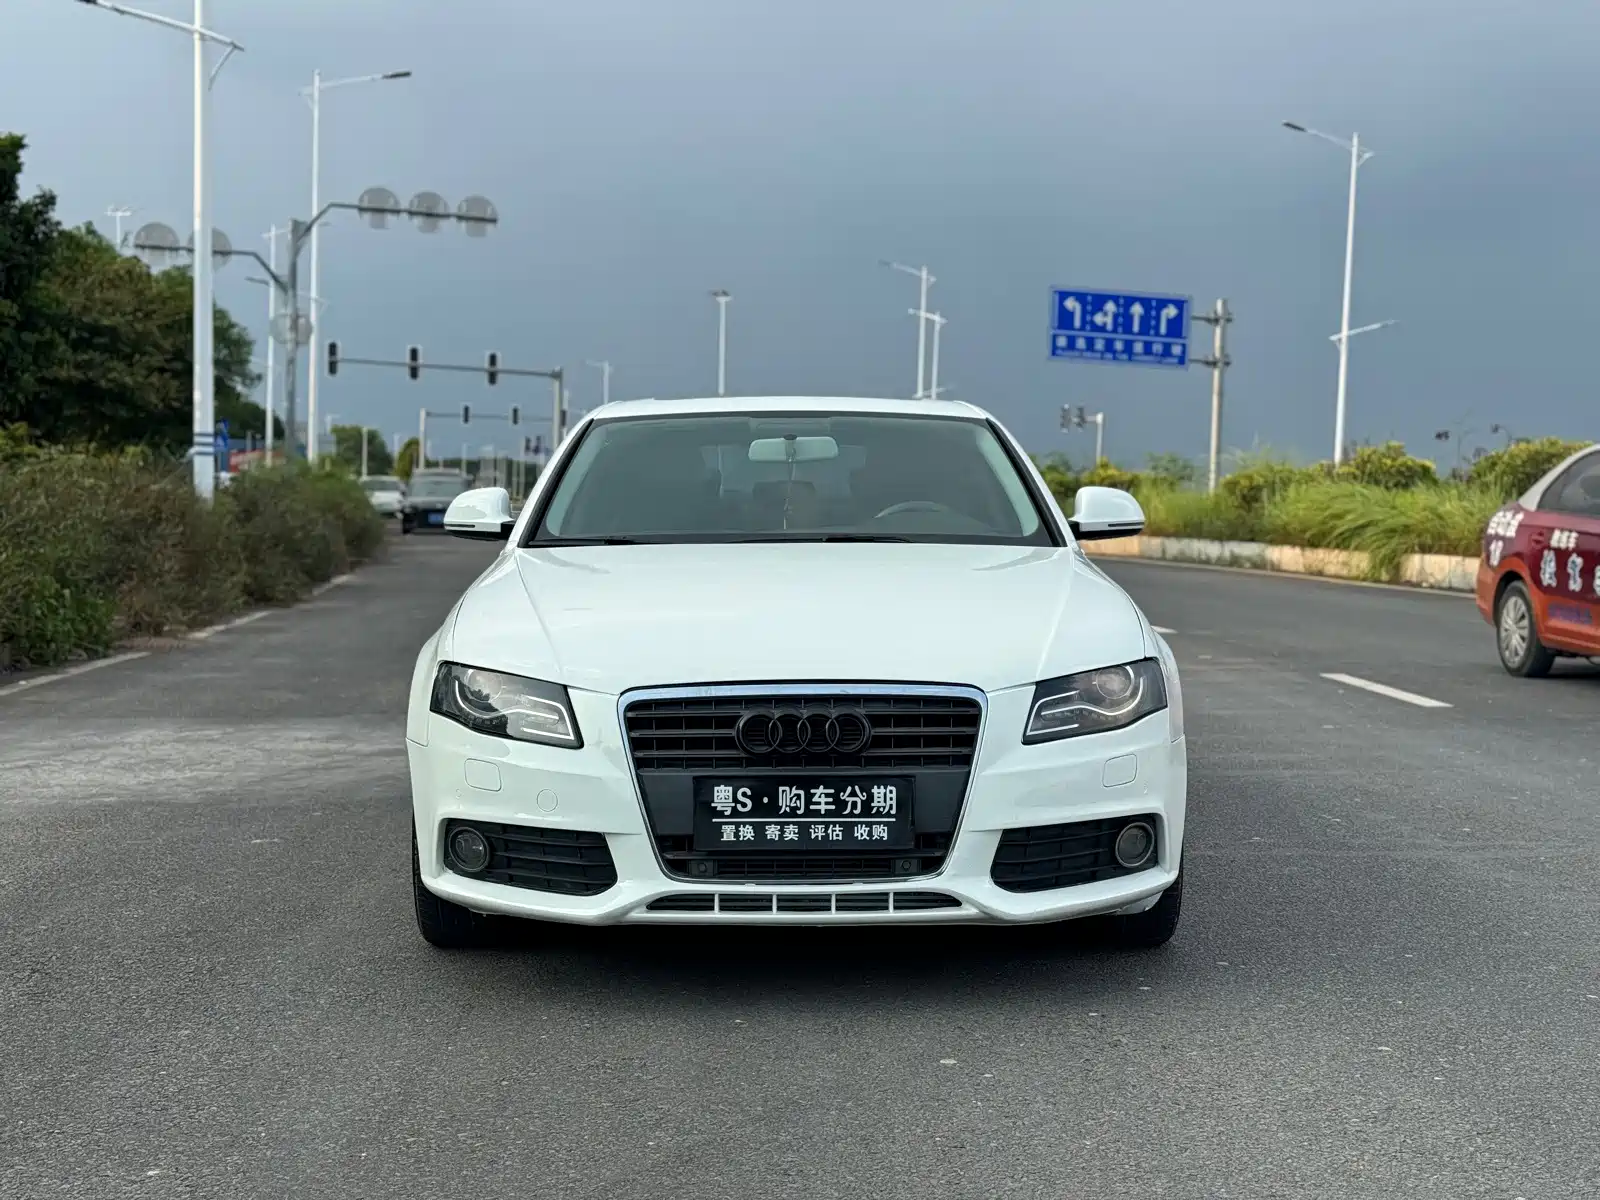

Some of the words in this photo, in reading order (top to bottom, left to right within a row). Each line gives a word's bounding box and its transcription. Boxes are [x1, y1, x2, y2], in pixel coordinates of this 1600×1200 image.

[720, 823, 755, 841] 置换
[764, 823, 800, 841] 寄卖
[809, 823, 844, 841] 评估
[853, 823, 888, 841] 收购
